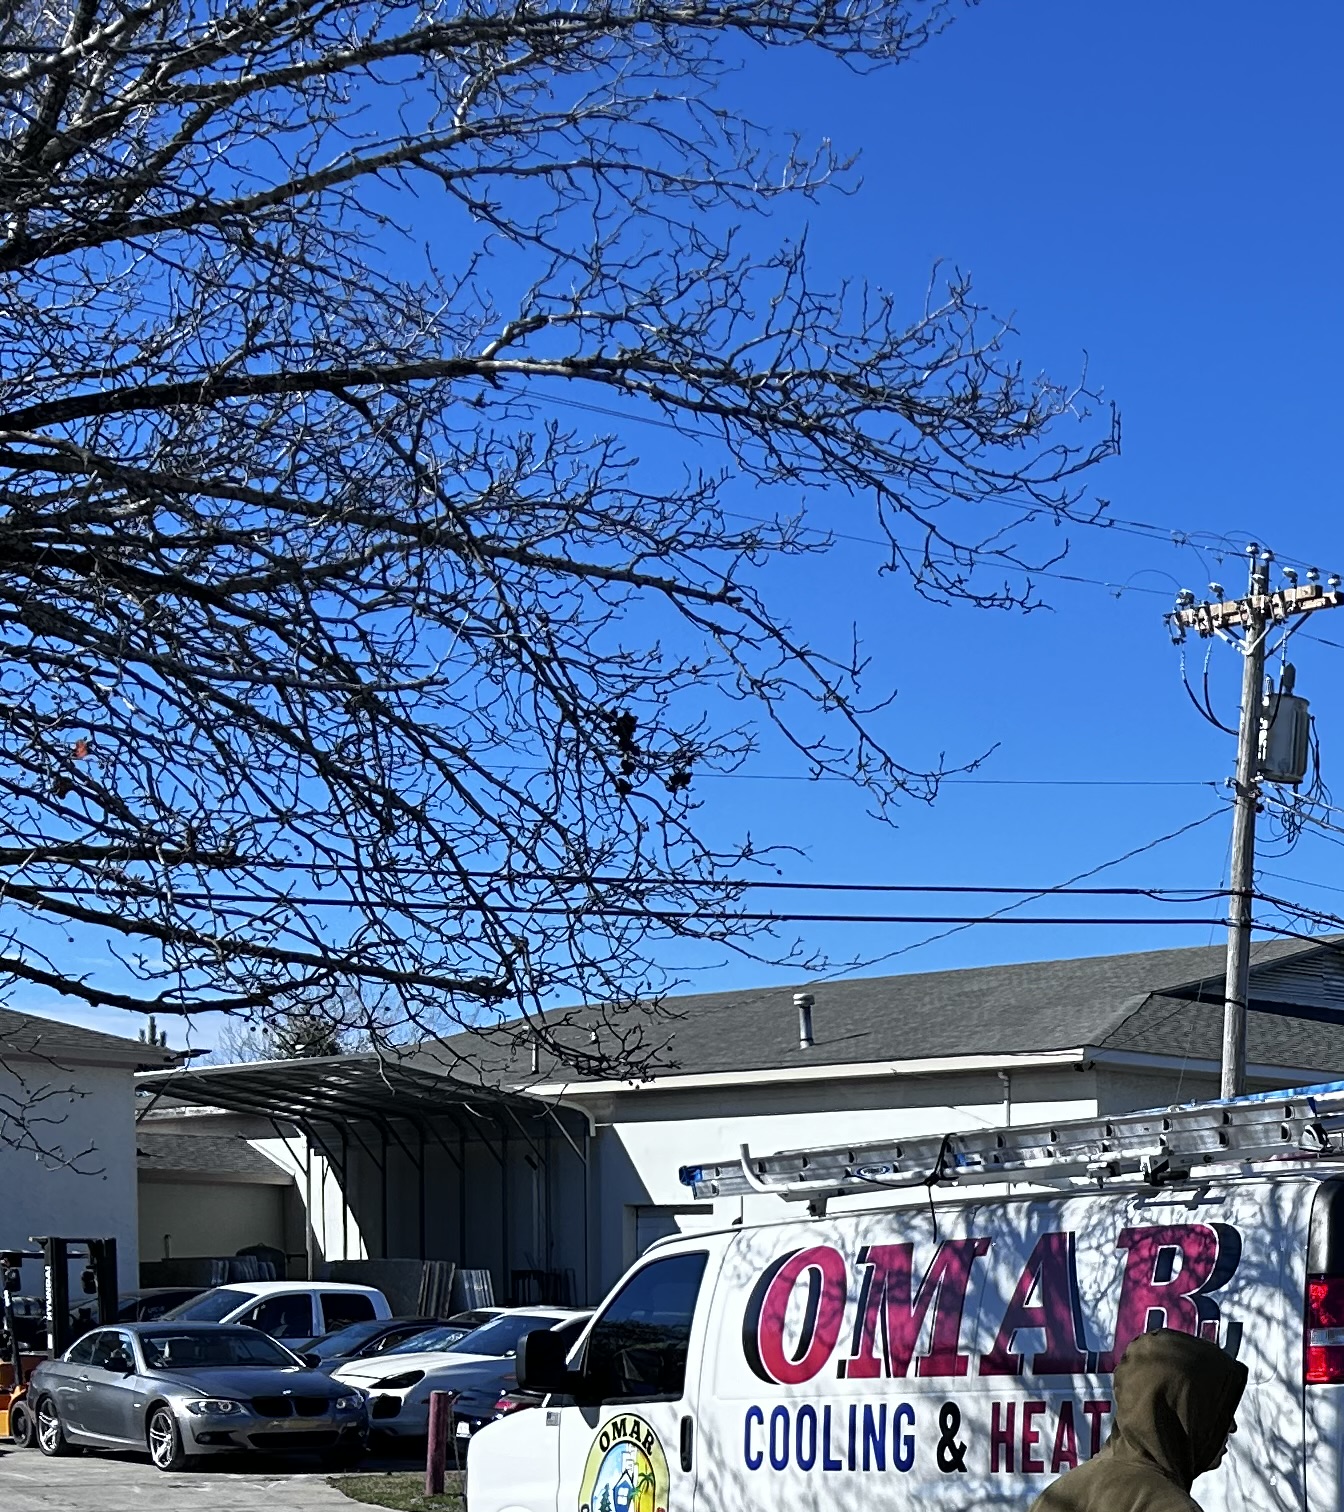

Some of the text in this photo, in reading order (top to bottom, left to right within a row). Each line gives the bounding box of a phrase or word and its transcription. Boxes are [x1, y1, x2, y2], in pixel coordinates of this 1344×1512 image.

[742, 1223, 1243, 1385] OMAR
[599, 1417, 655, 1456] OMAR
[745, 1400, 1112, 1473] COOLING & HEAT
